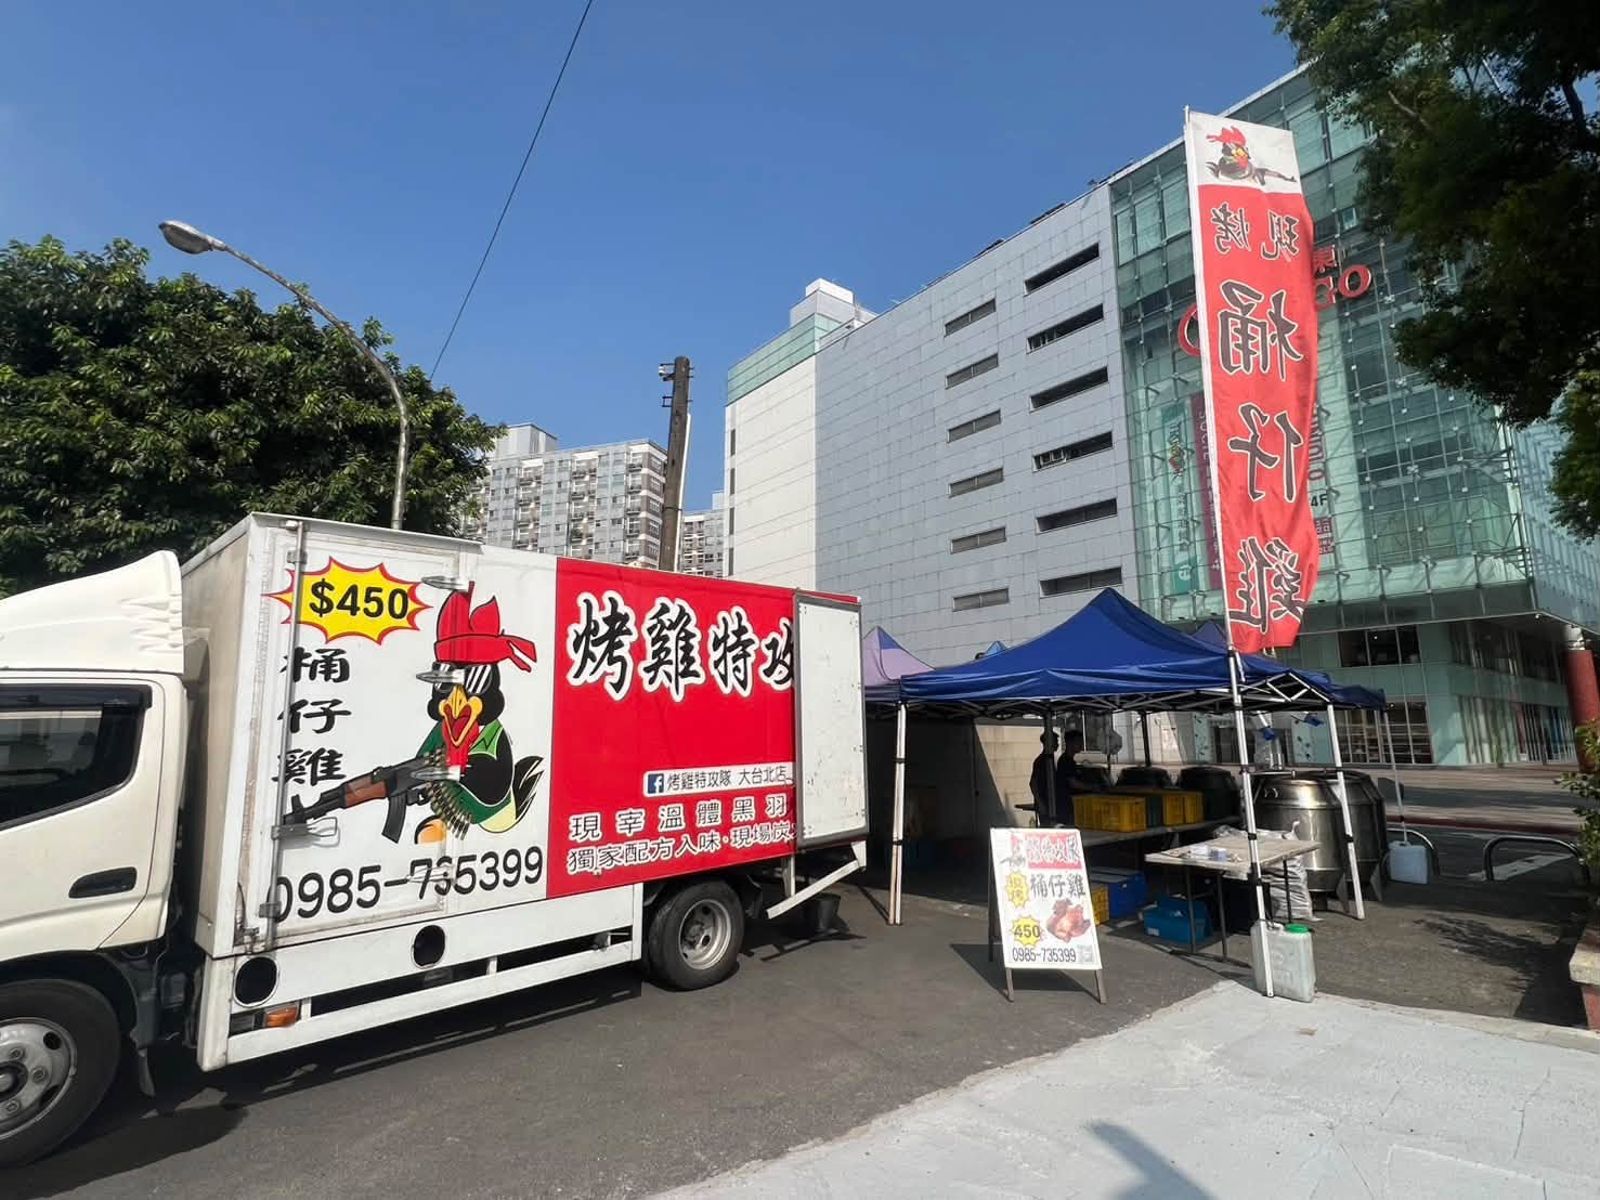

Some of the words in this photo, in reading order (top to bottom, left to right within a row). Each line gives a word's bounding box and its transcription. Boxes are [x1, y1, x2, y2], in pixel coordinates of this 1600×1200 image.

[309, 578, 409, 619] $450
[272, 646, 352, 786] 桶仔雞
[667, 770, 731, 791] 烤雞特攻隊
[738, 765, 788, 786] 大台北店
[567, 822, 798, 873] 獨家配方入味·現場炭
[268, 846, 543, 923] 0985-735399
[1014, 924, 1041, 939] 450
[1012, 947, 1077, 963] 0985-735399
